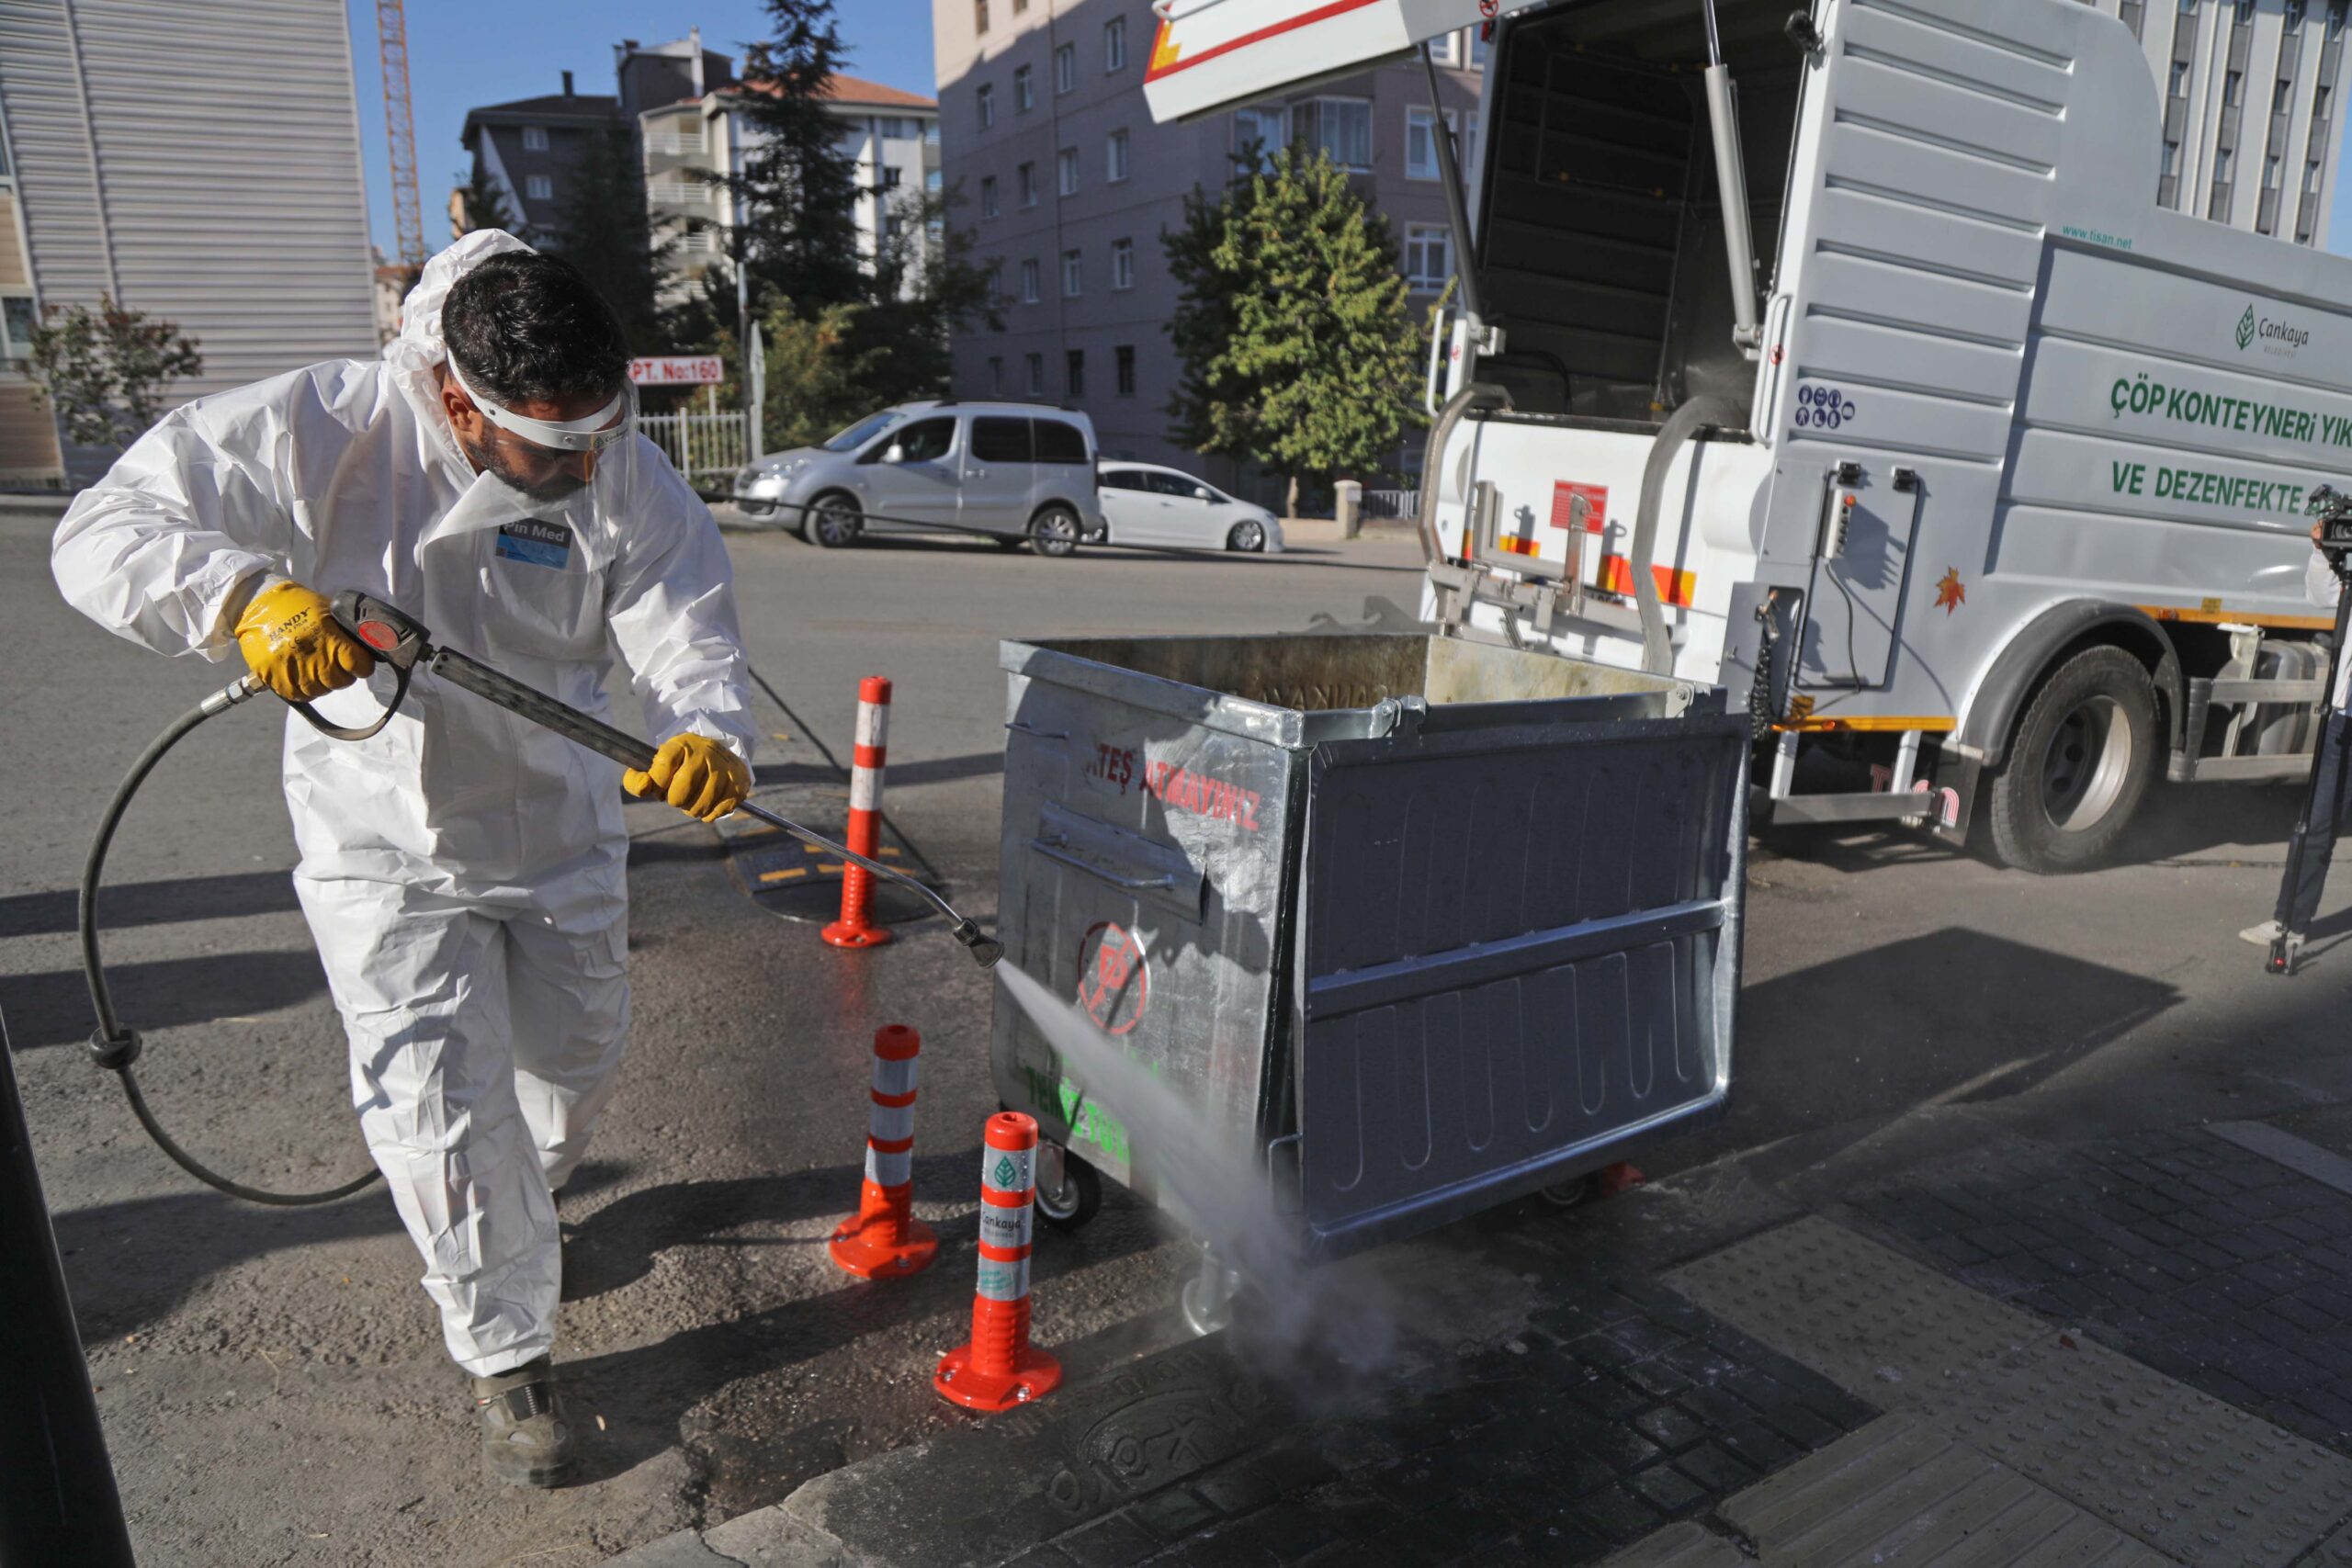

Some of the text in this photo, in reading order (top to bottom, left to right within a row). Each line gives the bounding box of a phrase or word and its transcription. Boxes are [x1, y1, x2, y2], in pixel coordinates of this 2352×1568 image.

[2062, 225, 2132, 250] www.tisan.net
[2258, 317, 2310, 348] Çankaya
[629, 360, 718, 381] PT. No:160
[2110, 372, 2165, 420] ÇÖP
[2112, 460, 2146, 496] VE
[2154, 466, 2304, 515] DEZENFEKTE
[532, 525, 565, 543] Med
[1139, 759, 1261, 832] ATMAYINIZ
